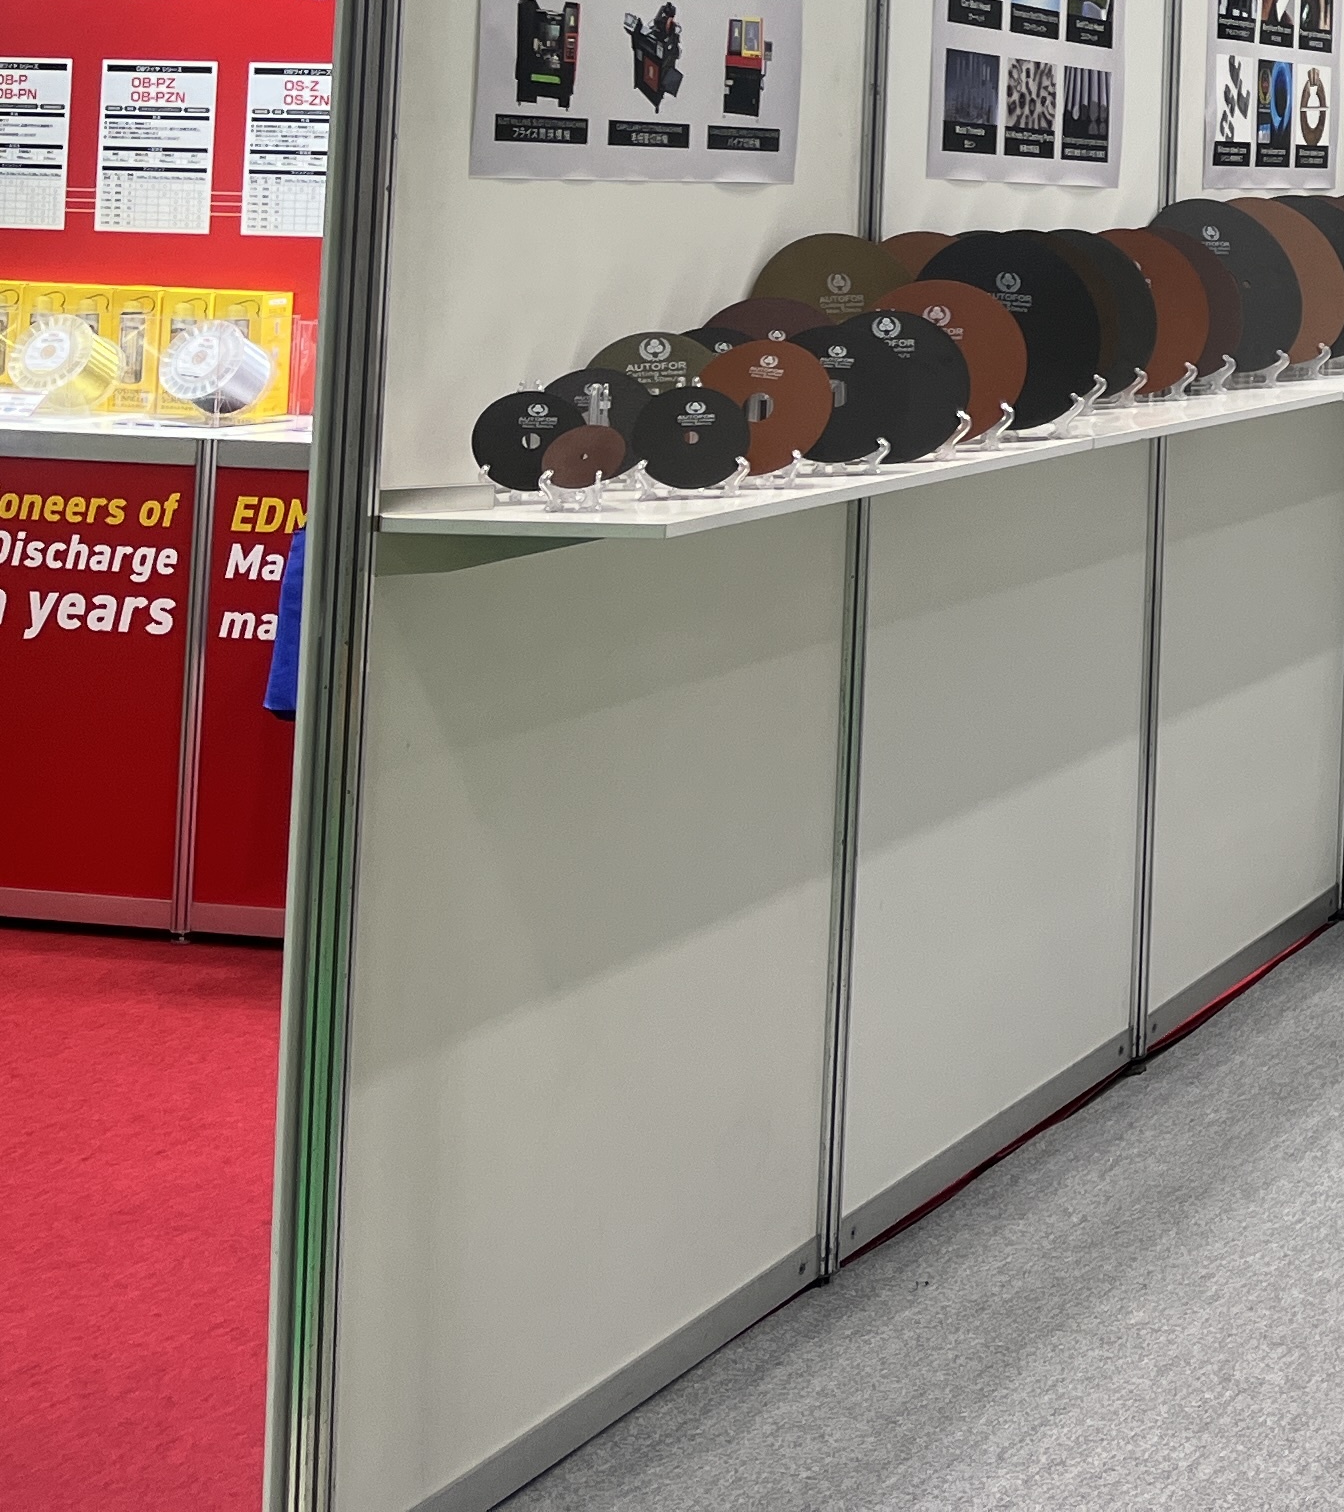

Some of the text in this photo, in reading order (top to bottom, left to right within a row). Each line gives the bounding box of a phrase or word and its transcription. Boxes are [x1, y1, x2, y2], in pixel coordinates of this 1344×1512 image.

[131, 76, 176, 89] OB-PZ
[285, 80, 319, 92] OS-Z
[130, 91, 186, 104] OB-PZN
[284, 94, 330, 106] OS-ZN
[820, 294, 864, 303] AUTOFOR
[626, 361, 687, 372] AUTOFOR
[139, 492, 181, 528] of
[23, 590, 177, 640] years
